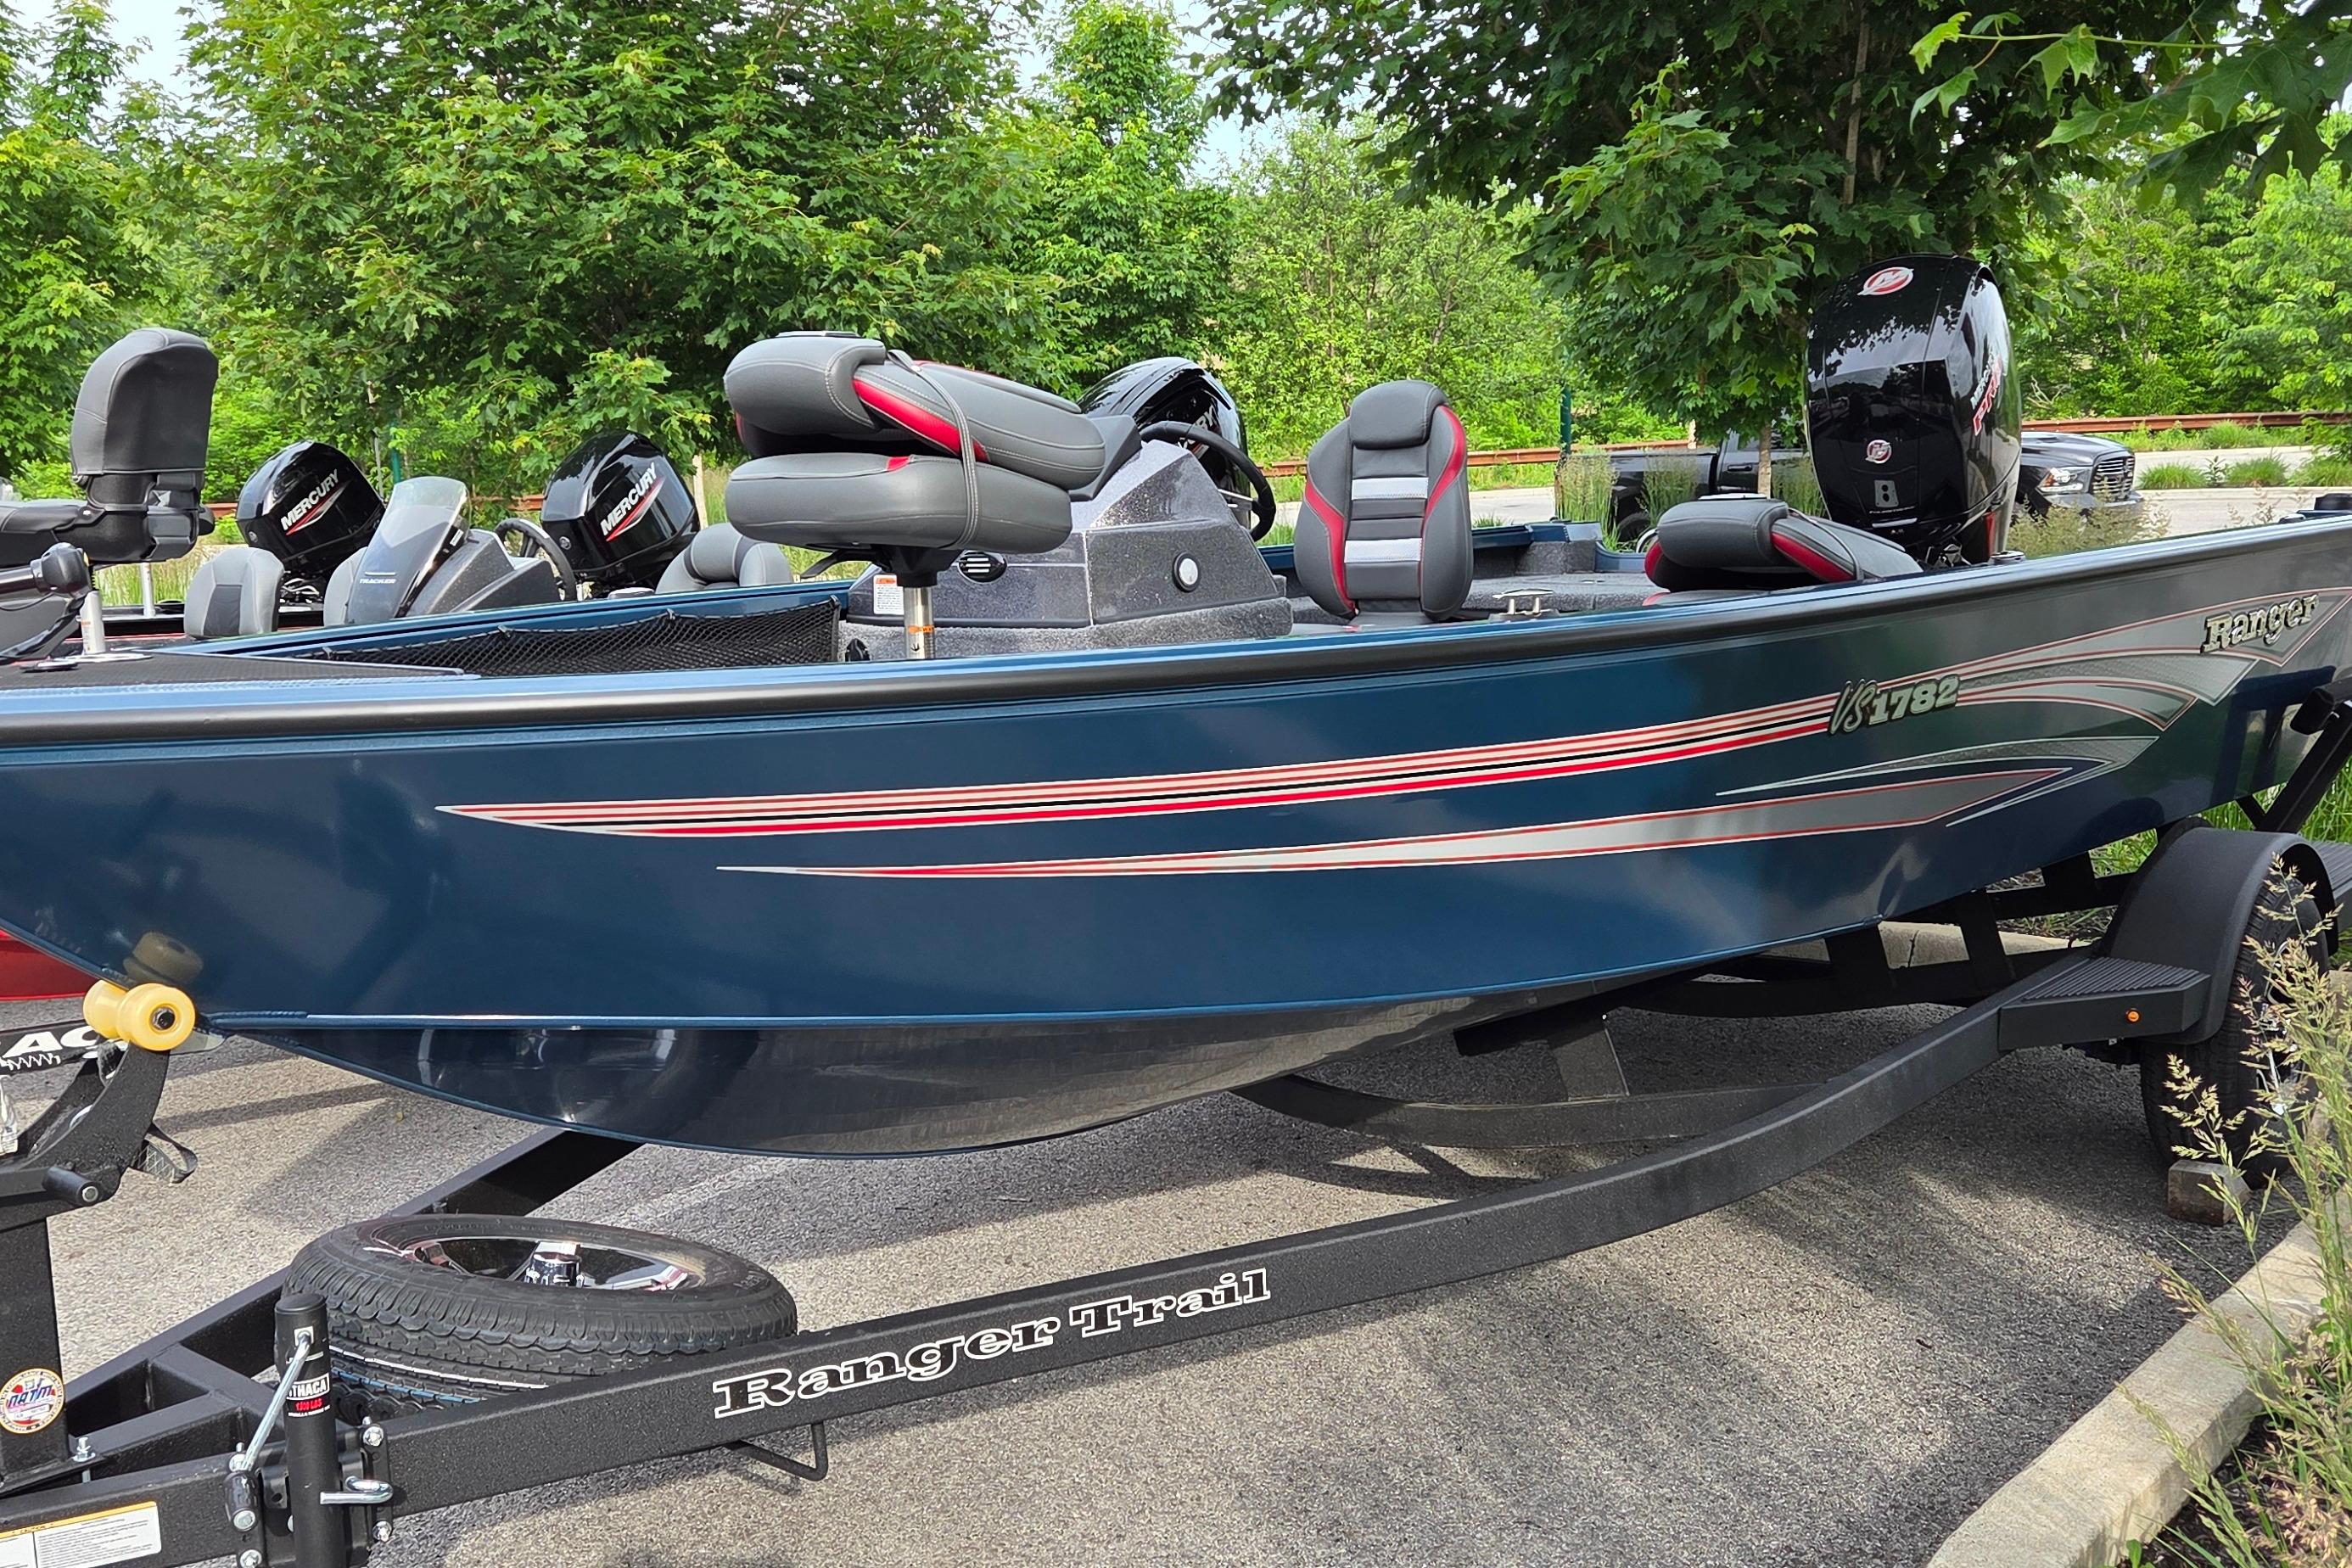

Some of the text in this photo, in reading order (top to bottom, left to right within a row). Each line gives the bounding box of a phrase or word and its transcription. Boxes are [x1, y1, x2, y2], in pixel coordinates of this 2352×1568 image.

[280, 468, 339, 531] MERCURY
[598, 461, 657, 536] MERCURY
[2200, 593, 2320, 654] Ranger
[713, 1268, 1271, 1420] Ranger Trail
